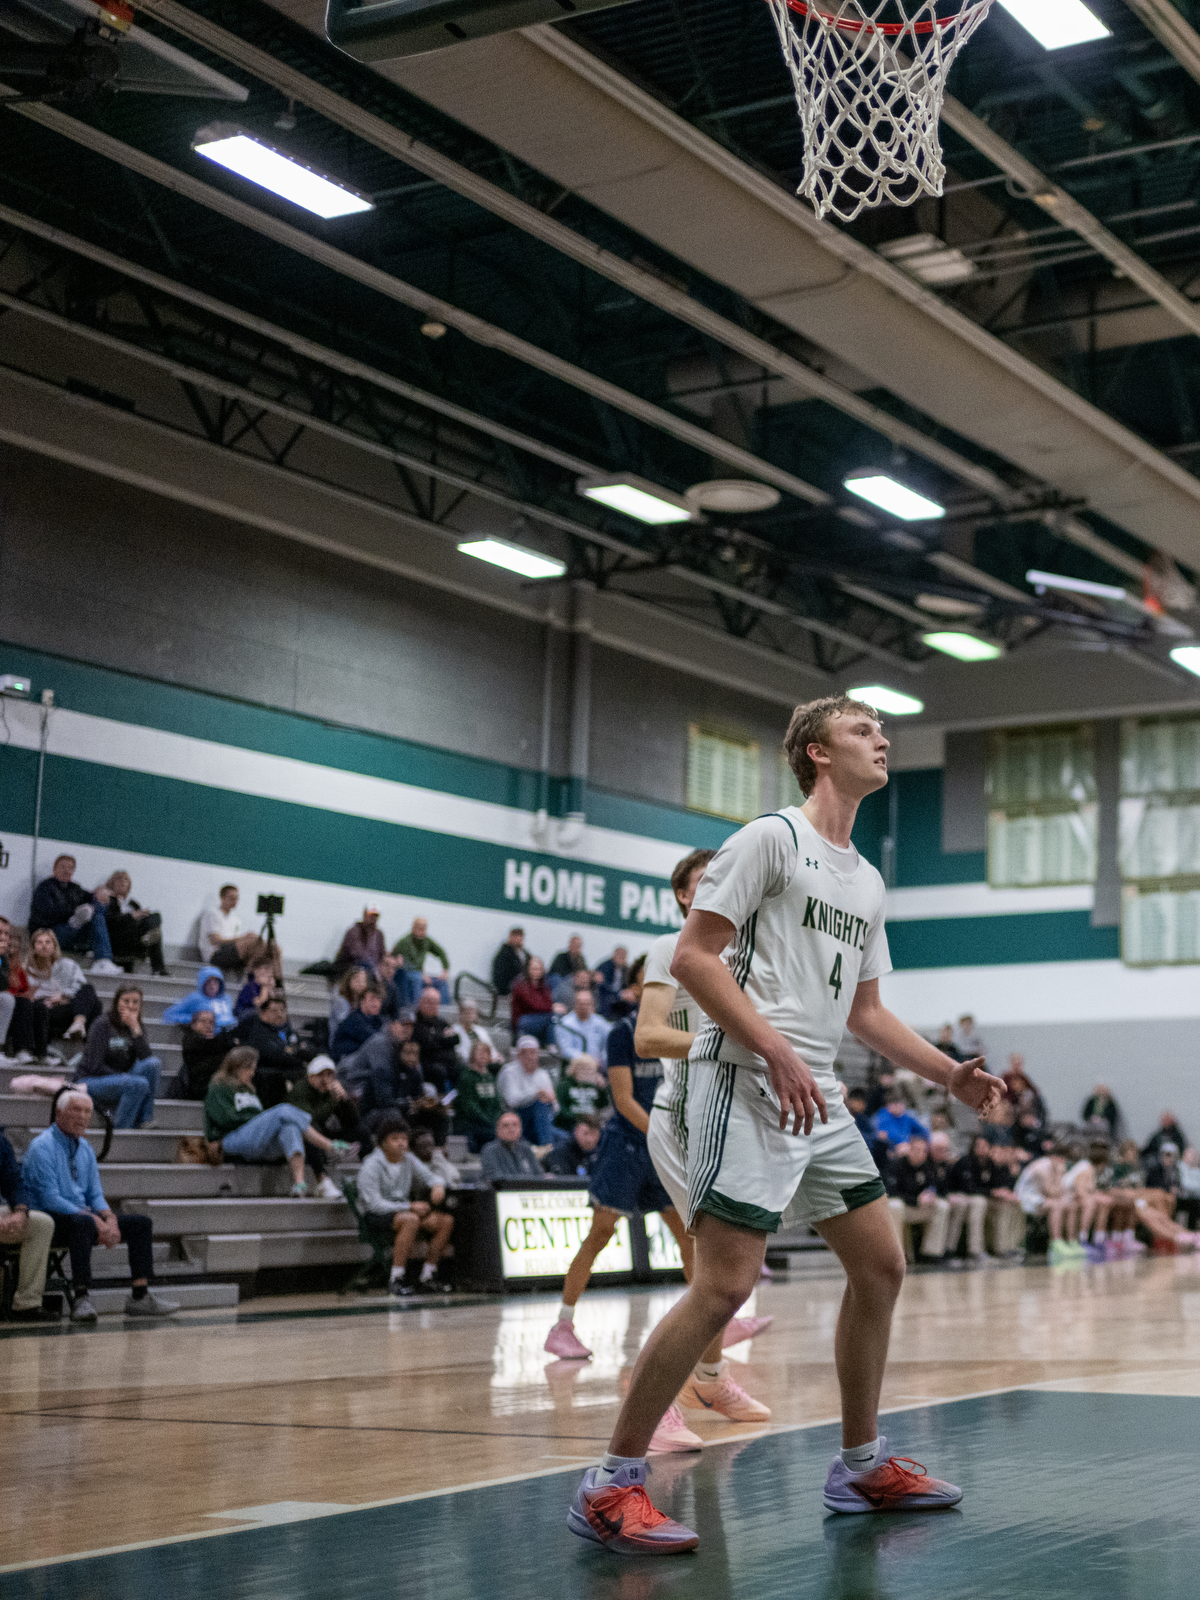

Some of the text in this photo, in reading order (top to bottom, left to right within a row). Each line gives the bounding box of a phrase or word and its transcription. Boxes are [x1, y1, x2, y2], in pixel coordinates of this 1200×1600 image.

[504, 858, 687, 929] HOME PAR
[828, 952, 842, 1000] 4
[504, 1216, 627, 1253] CENTUY
